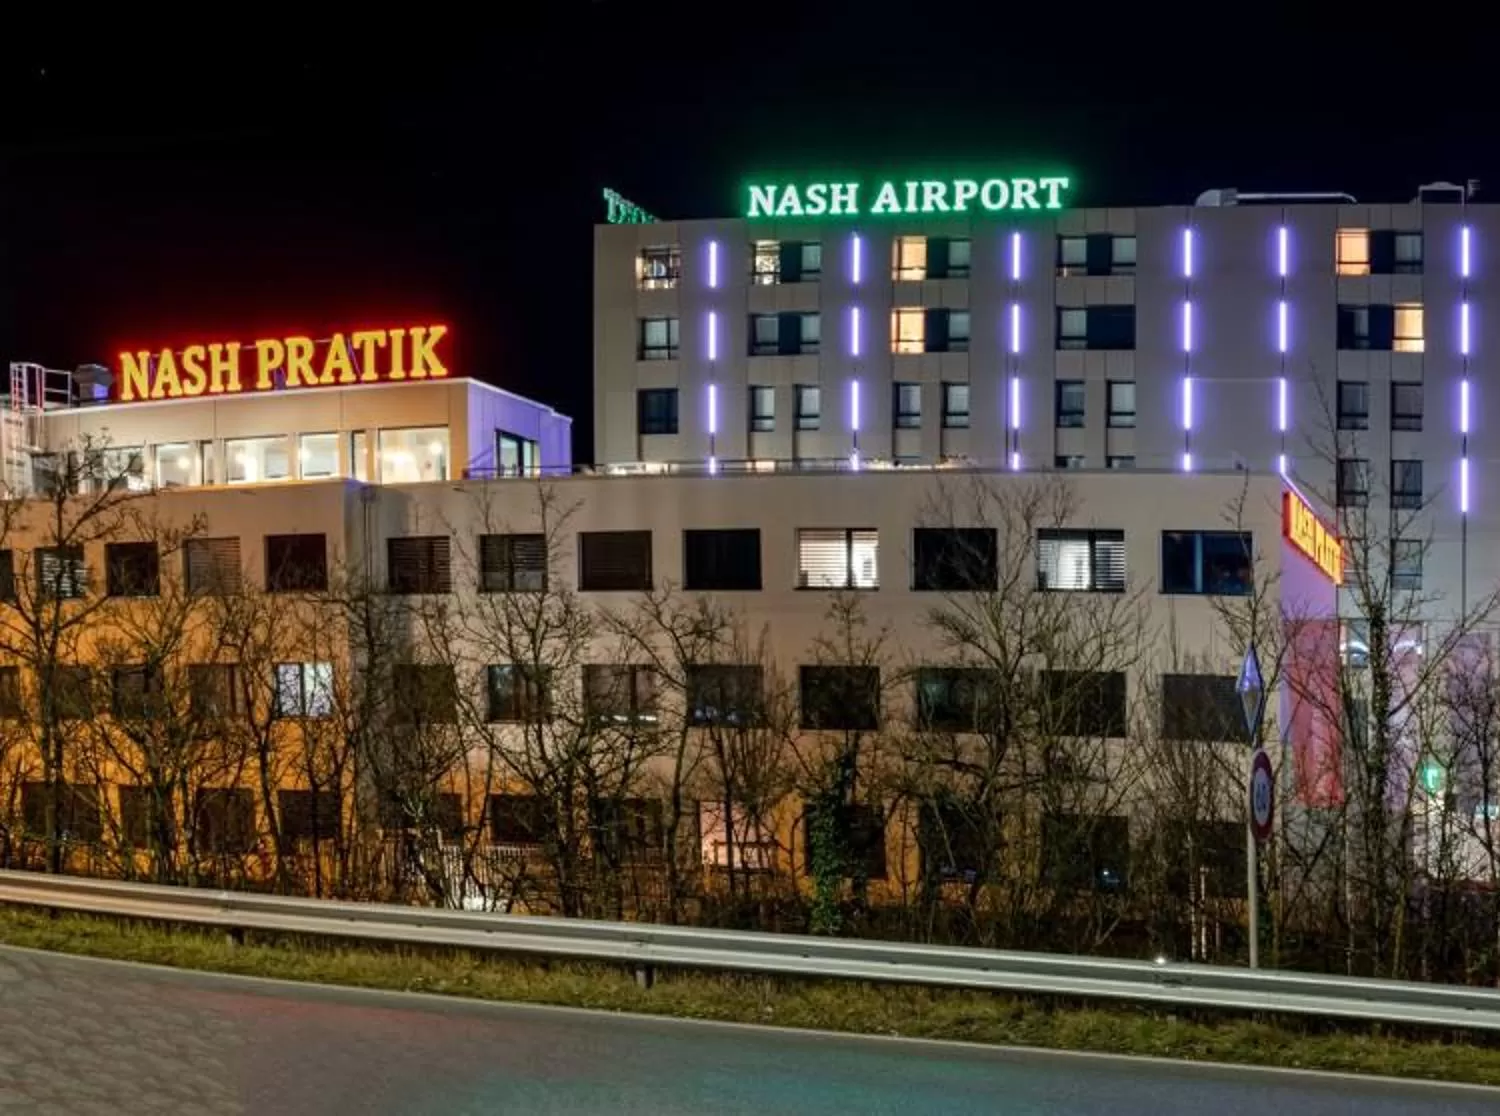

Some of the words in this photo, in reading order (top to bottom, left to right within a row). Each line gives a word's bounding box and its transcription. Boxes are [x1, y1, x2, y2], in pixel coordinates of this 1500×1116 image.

[748, 182, 860, 217] NASH
[870, 177, 1069, 214] AIRPORT
[119, 342, 242, 400] NASH
[256, 325, 448, 389] PRATIK
